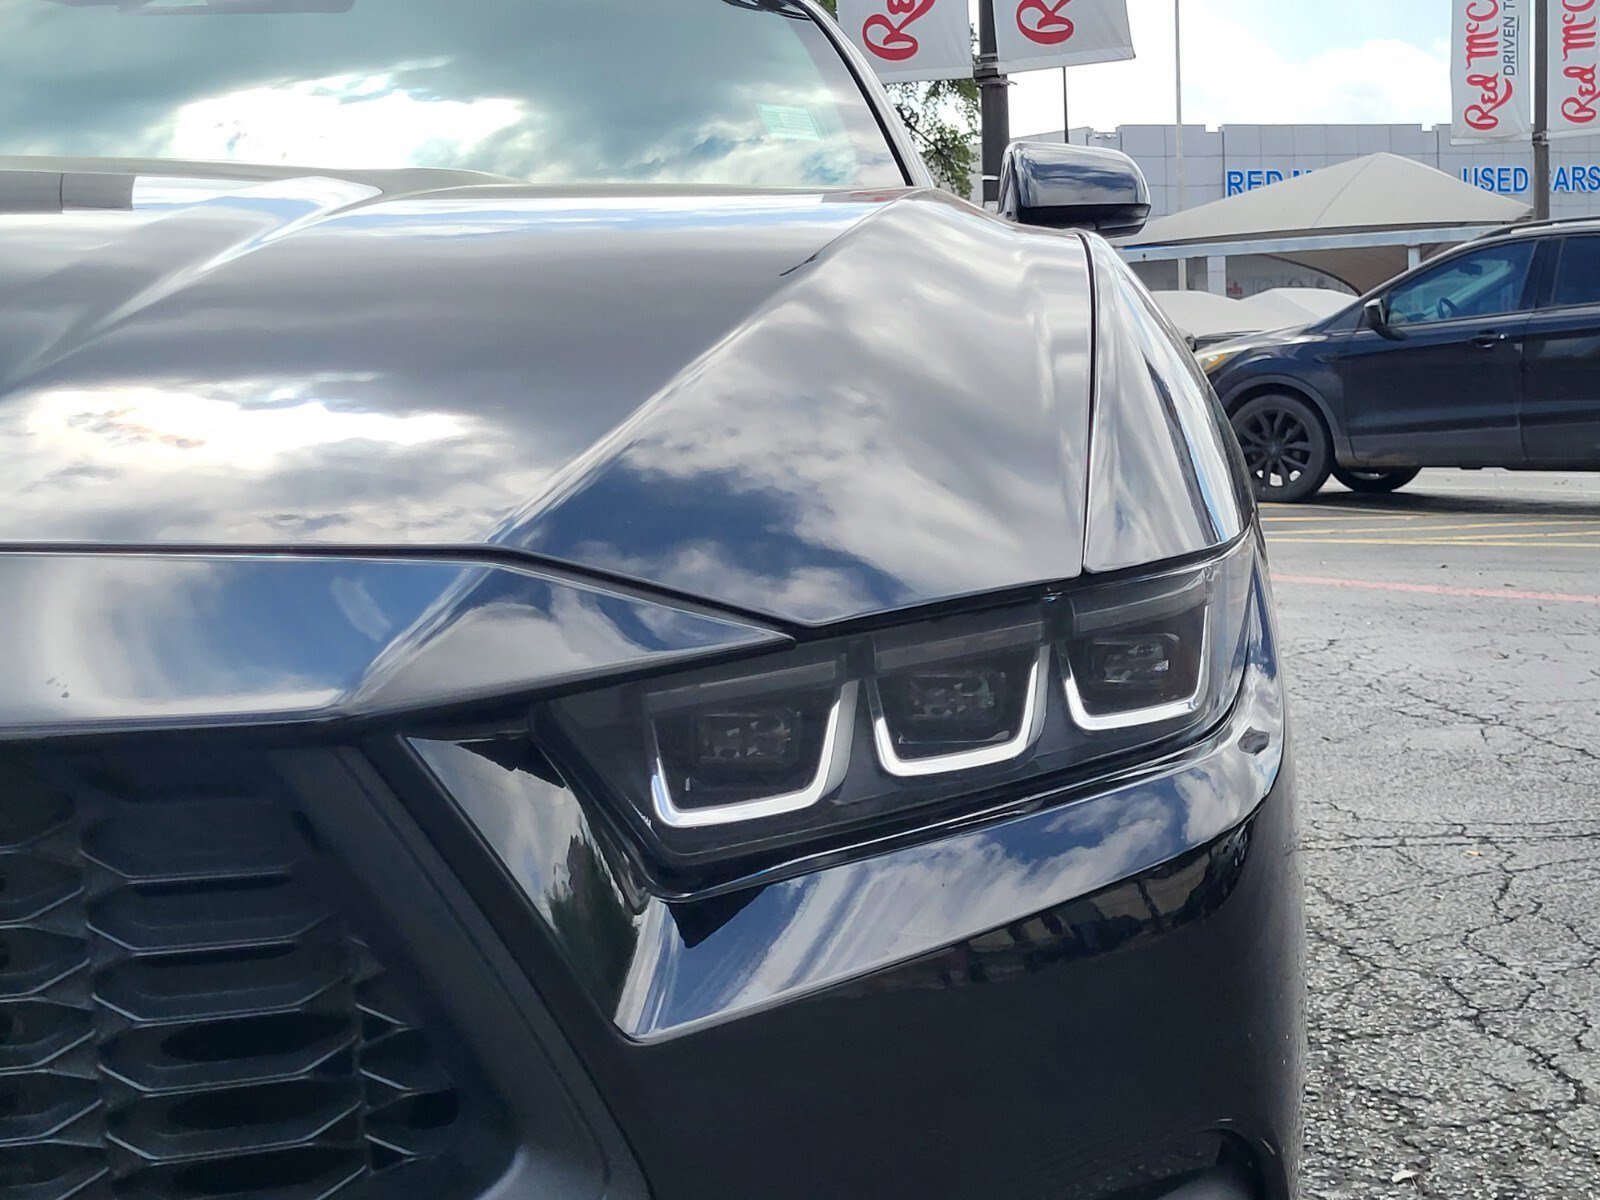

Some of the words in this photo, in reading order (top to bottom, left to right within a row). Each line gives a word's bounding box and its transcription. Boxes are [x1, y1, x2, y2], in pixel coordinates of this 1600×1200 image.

[1465, 0, 1499, 70] McC
[1503, 0, 1516, 11] T
[1561, 0, 1597, 62] McC
[1503, 16, 1516, 76] DRIVEN
[1464, 72, 1513, 130] Red
[1561, 63, 1600, 124] Red
[1462, 166, 1529, 193] USED
[1552, 165, 1600, 192] ARS
